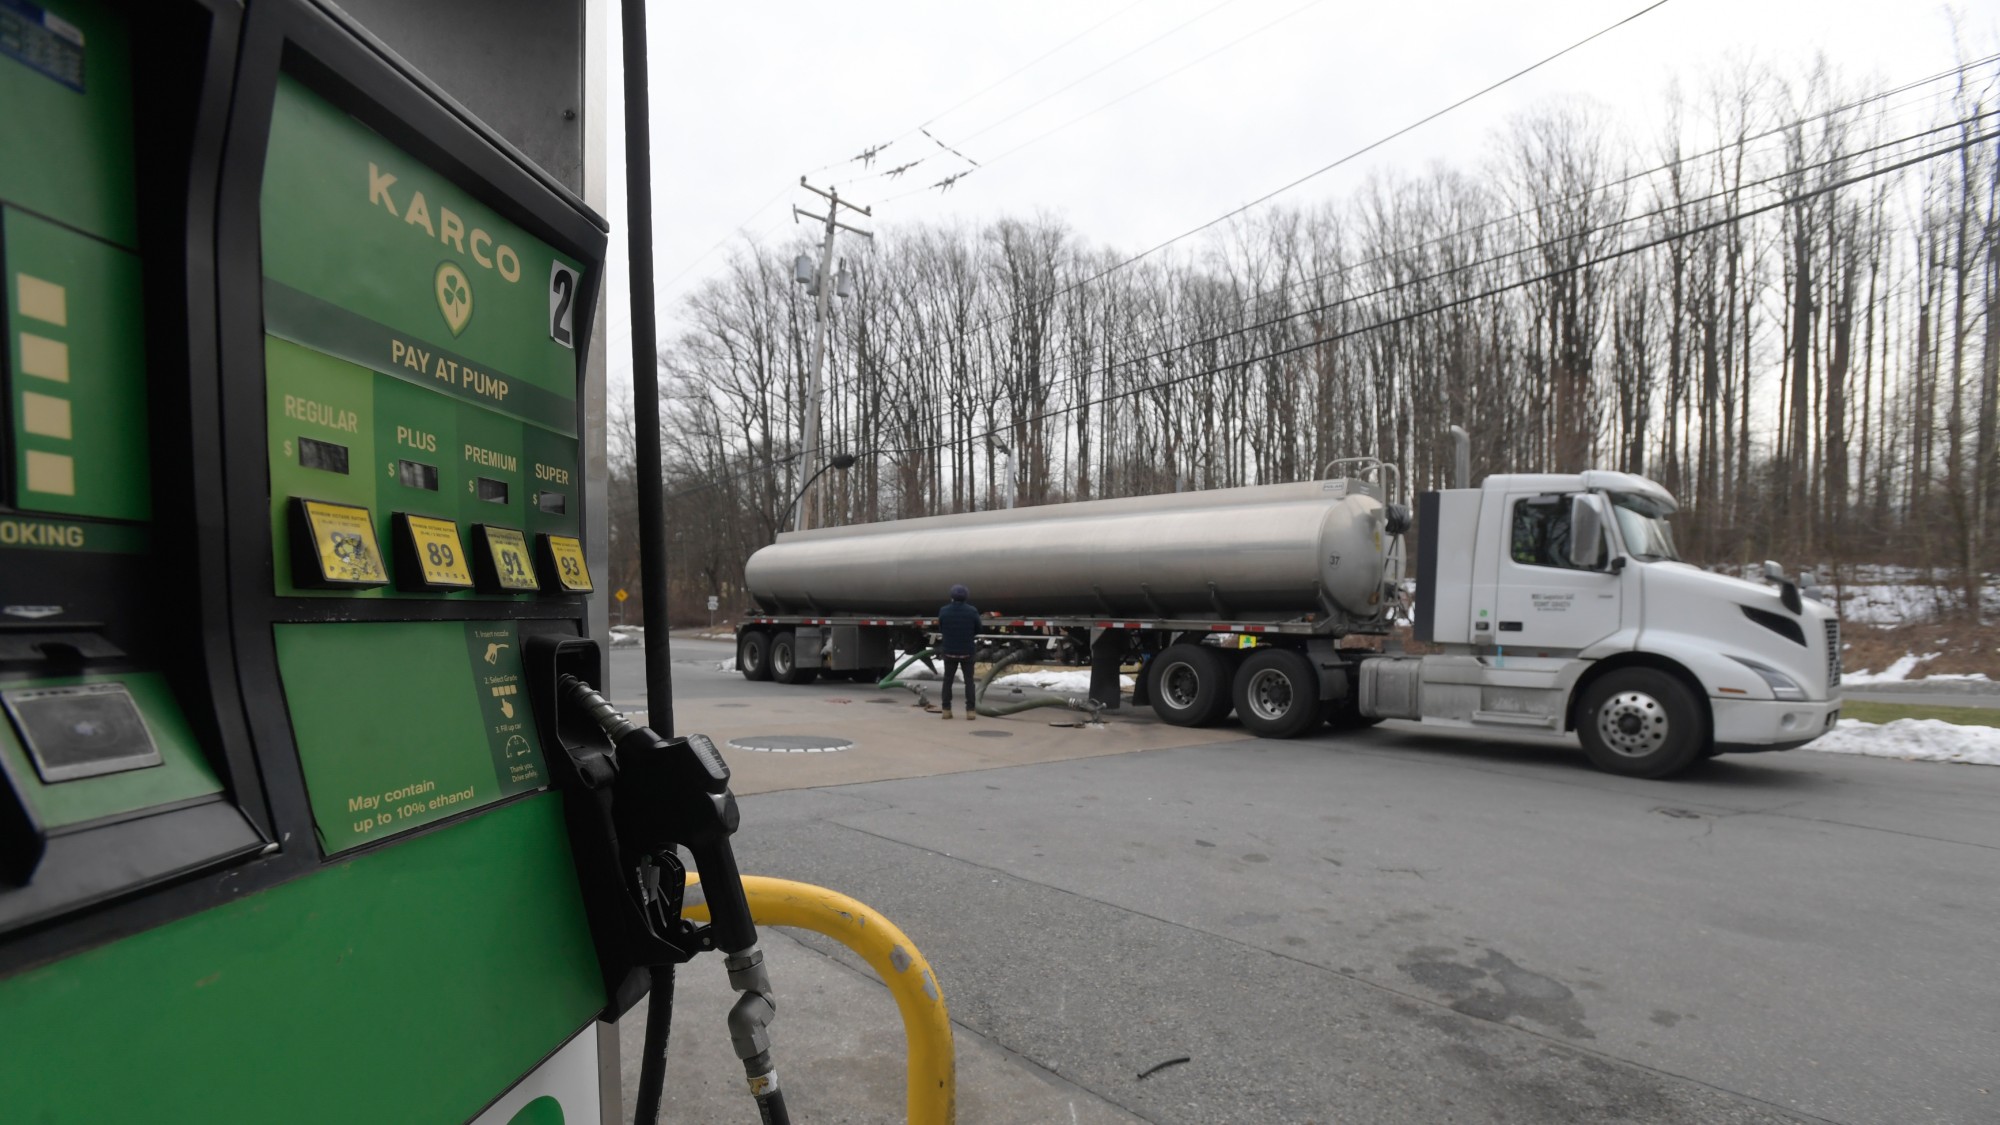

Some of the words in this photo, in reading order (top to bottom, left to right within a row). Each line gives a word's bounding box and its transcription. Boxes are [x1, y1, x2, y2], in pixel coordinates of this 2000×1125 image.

[368, 161, 521, 283] KARCO
[552, 269, 574, 345] 2
[391, 339, 431, 374] PAY
[435, 357, 458, 384] AT
[463, 366, 509, 401] PUMP
[284, 394, 358, 434] REGULAR
[283, 440, 293, 457] $
[397, 425, 437, 453] PLUS
[387, 462, 395, 478] $
[464, 444, 517, 473] PREMIUM
[468, 479, 475, 493] $
[535, 462, 569, 486] SUPER
[532, 493, 538, 505] $
[0, 521, 85, 547] OKING
[426, 542, 454, 568] 89
[501, 548, 525, 576] 91
[560, 556, 580, 576] 93
[1329, 555, 1341, 566] 37
[348, 794, 380, 813] May
[384, 780, 435, 803] contain
[353, 817, 374, 833] up
[376, 812, 392, 826] to
[396, 802, 426, 819] 10%
[428, 785, 475, 810] ethanol
